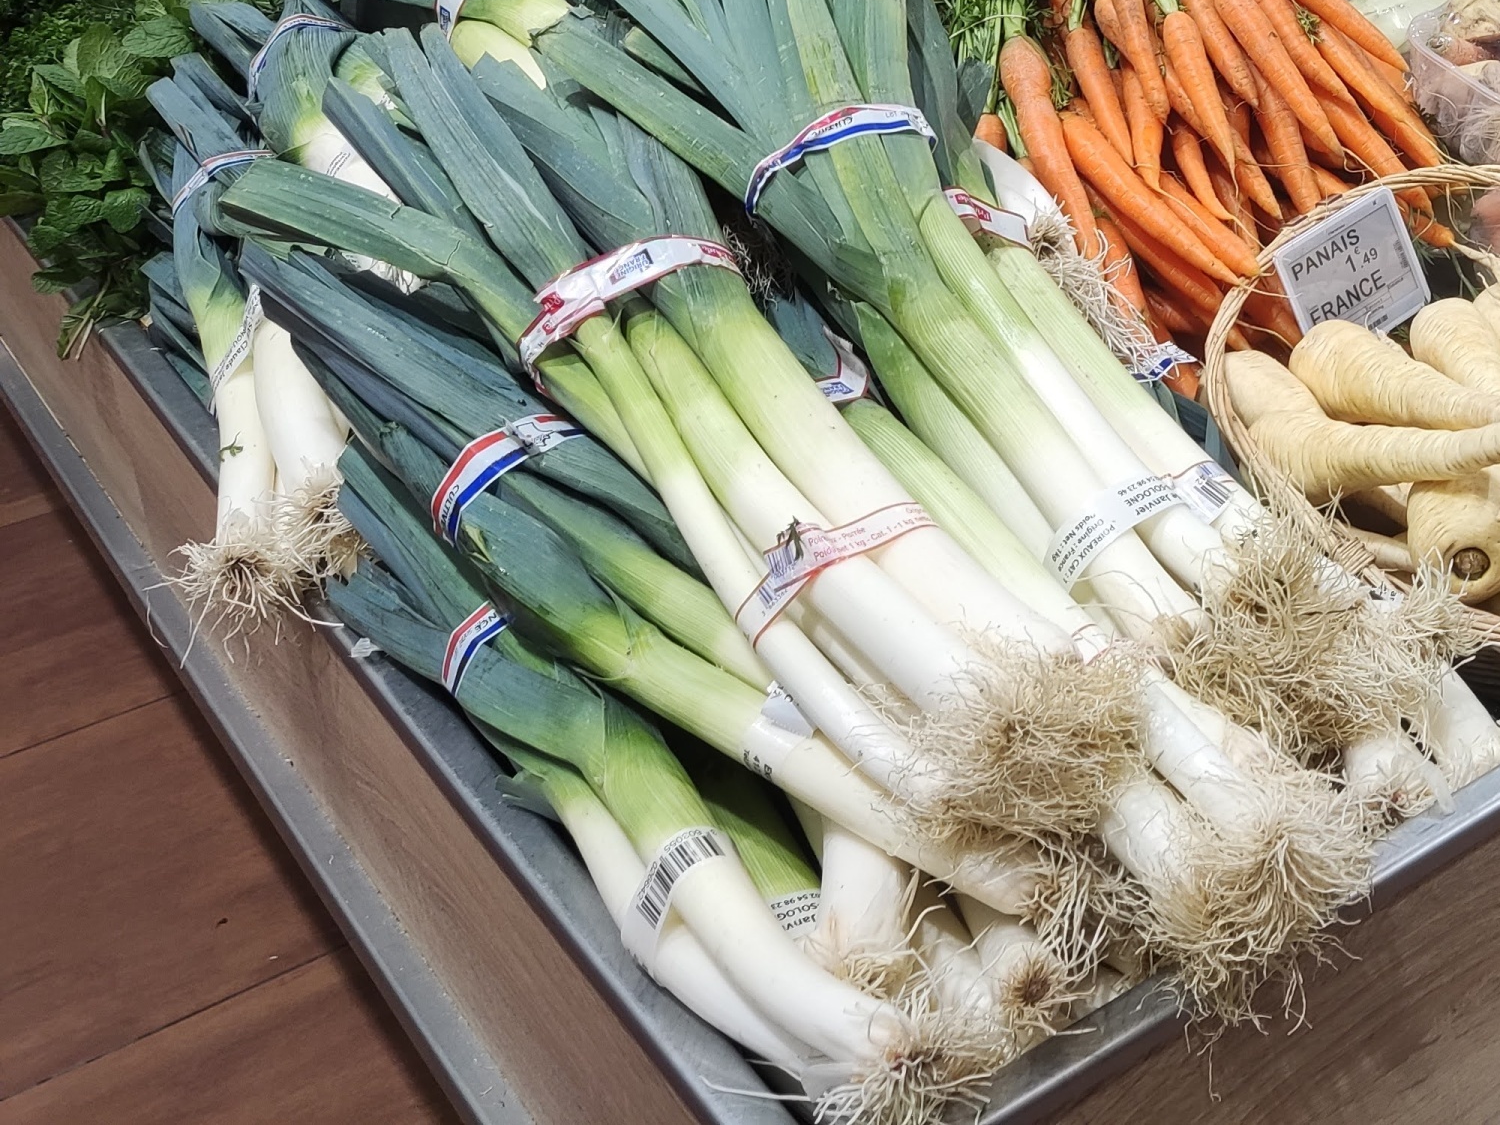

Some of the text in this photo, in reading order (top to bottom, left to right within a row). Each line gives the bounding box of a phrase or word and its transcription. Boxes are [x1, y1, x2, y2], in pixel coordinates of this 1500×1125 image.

[1291, 229, 1360, 281] PANAIS
[1309, 269, 1386, 325] FRANCE
[1135, 494, 1174, 516] Janvier
[1078, 518, 1105, 545] Origine
[1080, 524, 1116, 560] POIREAUX
[774, 902, 820, 922] -SOLOG
